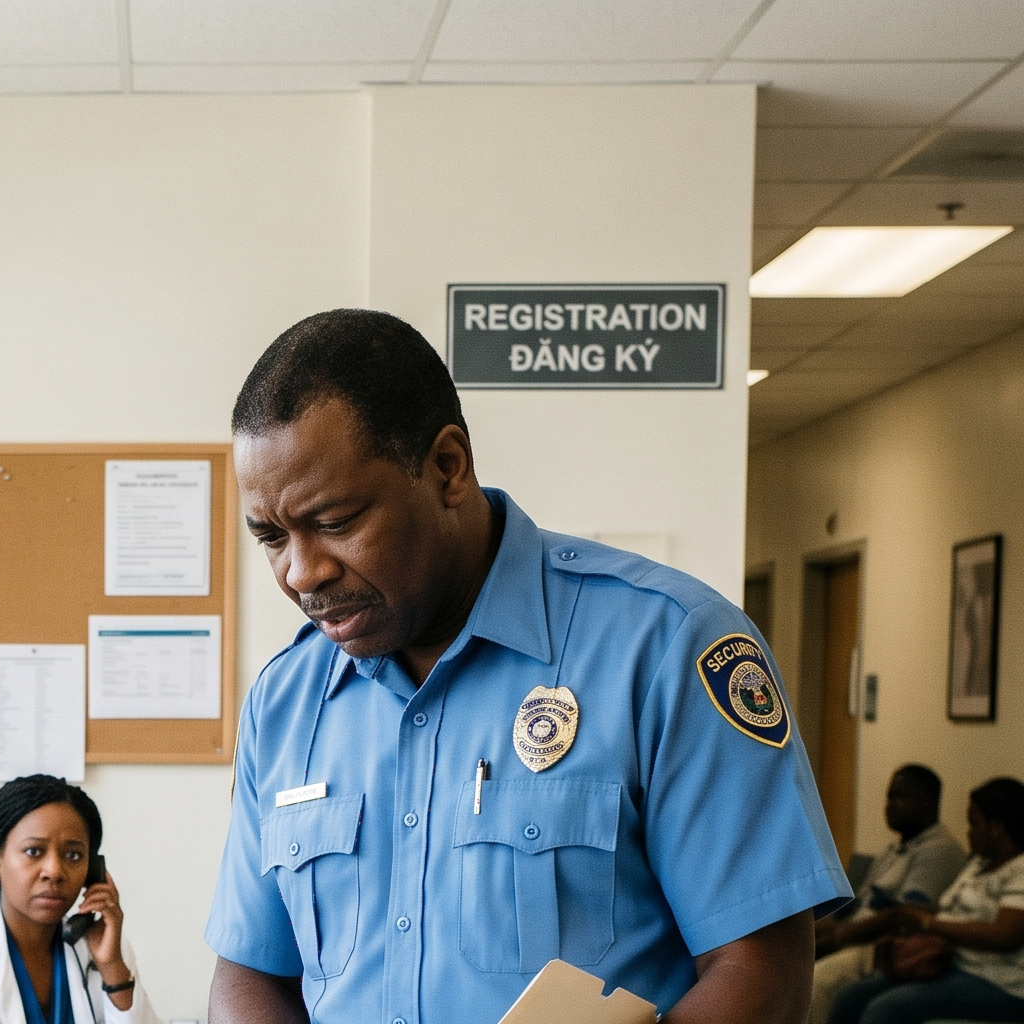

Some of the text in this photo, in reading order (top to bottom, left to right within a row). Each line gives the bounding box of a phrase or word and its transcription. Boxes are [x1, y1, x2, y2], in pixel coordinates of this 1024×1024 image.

[464, 303, 707, 331] REGISTRATION
[508, 337, 660, 372] ĐĂNG KÝ
